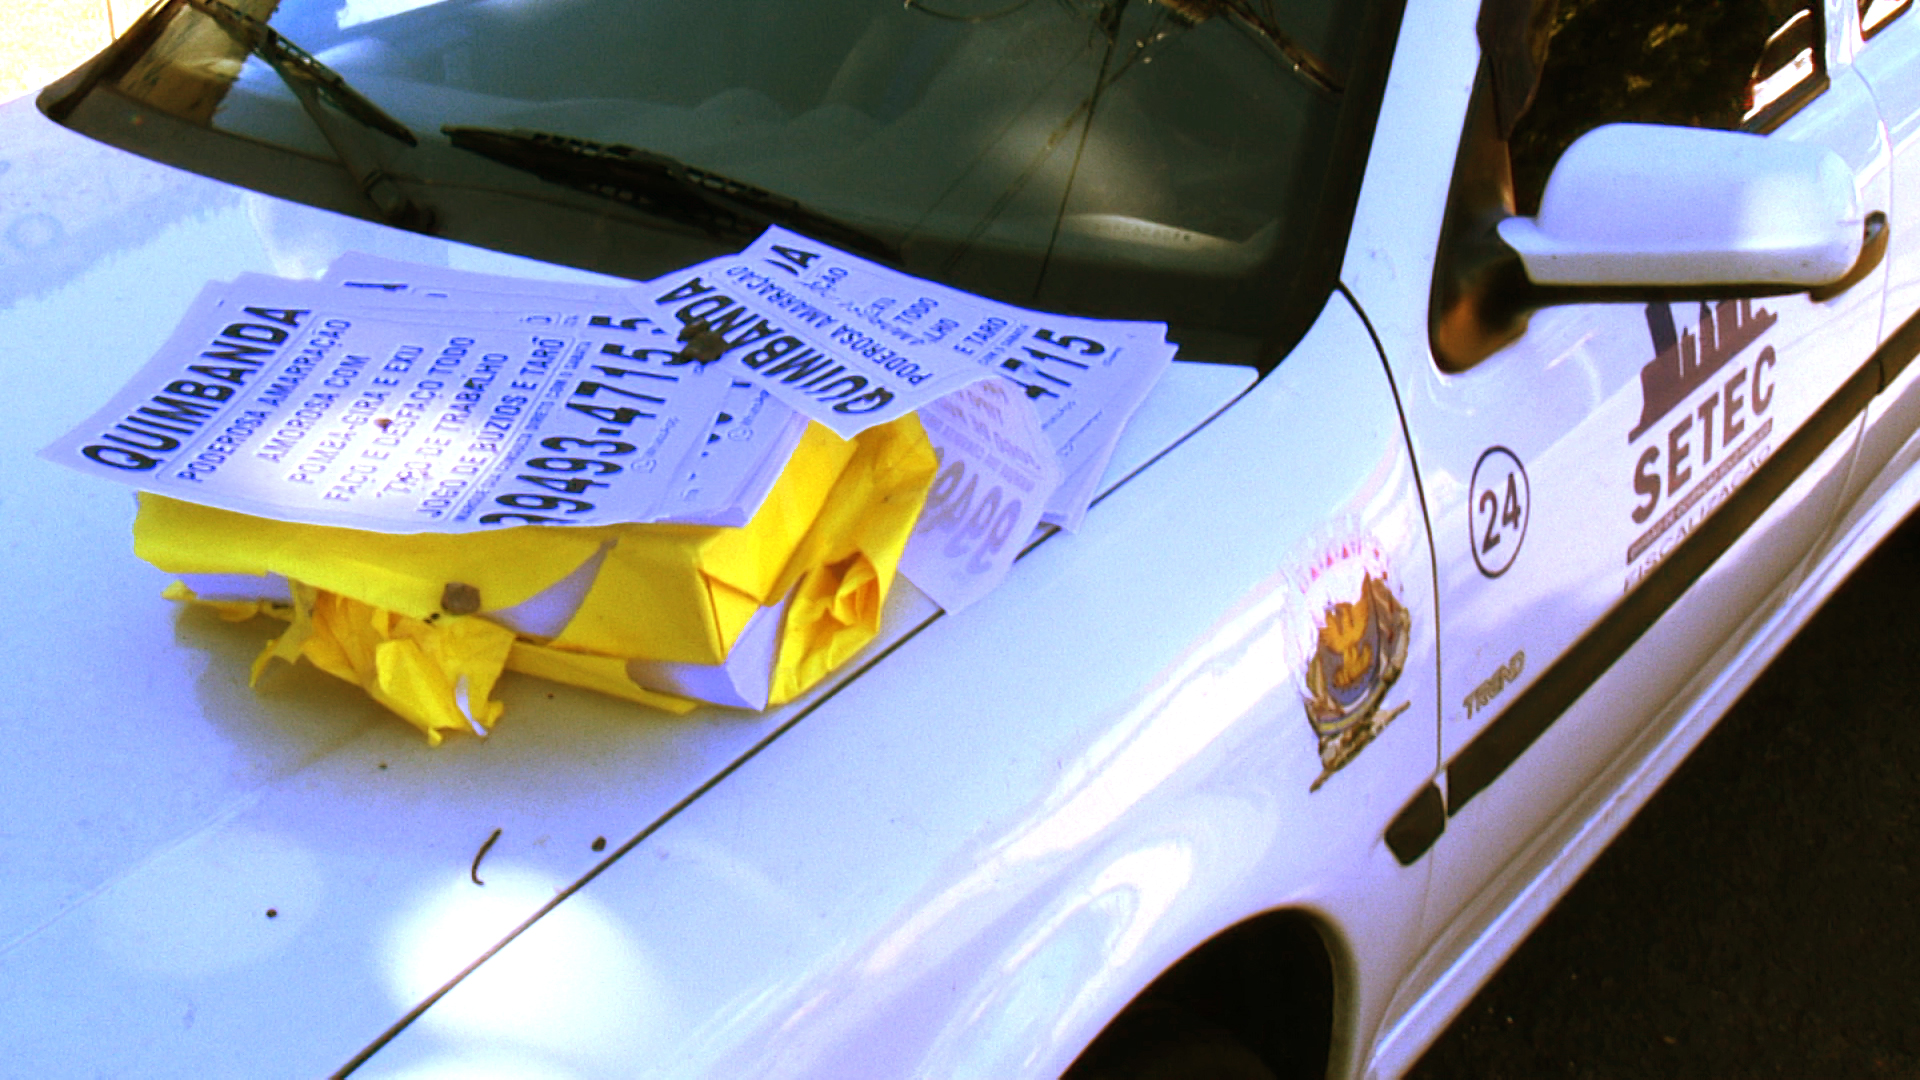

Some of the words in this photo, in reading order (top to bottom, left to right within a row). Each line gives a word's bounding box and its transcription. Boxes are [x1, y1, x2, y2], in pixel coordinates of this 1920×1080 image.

[80, 306, 311, 472] QUIMBANDA
[372, 376, 400, 386] E
[383, 345, 424, 373] EXU
[433, 353, 508, 432] TRABALHO
[655, 277, 896, 415] QUIMBANDA
[830, 323, 934, 386] PODEROSA
[176, 410, 273, 483] PODEROSA
[256, 318, 352, 407] AMARRAÇÃO
[255, 392, 341, 464] AMOROSA
[323, 354, 371, 388] COM
[287, 391, 392, 485] POMBA-GIRA
[322, 465, 378, 501] FAÇO
[360, 449, 390, 460] E
[428, 337, 475, 375] TODO
[415, 437, 452, 455] DE
[416, 479, 468, 517] JOGO
[450, 455, 488, 474] DE
[511, 381, 538, 391] E
[1631, 344, 1777, 525] SETEC
[1479, 471, 1522, 555] 24
